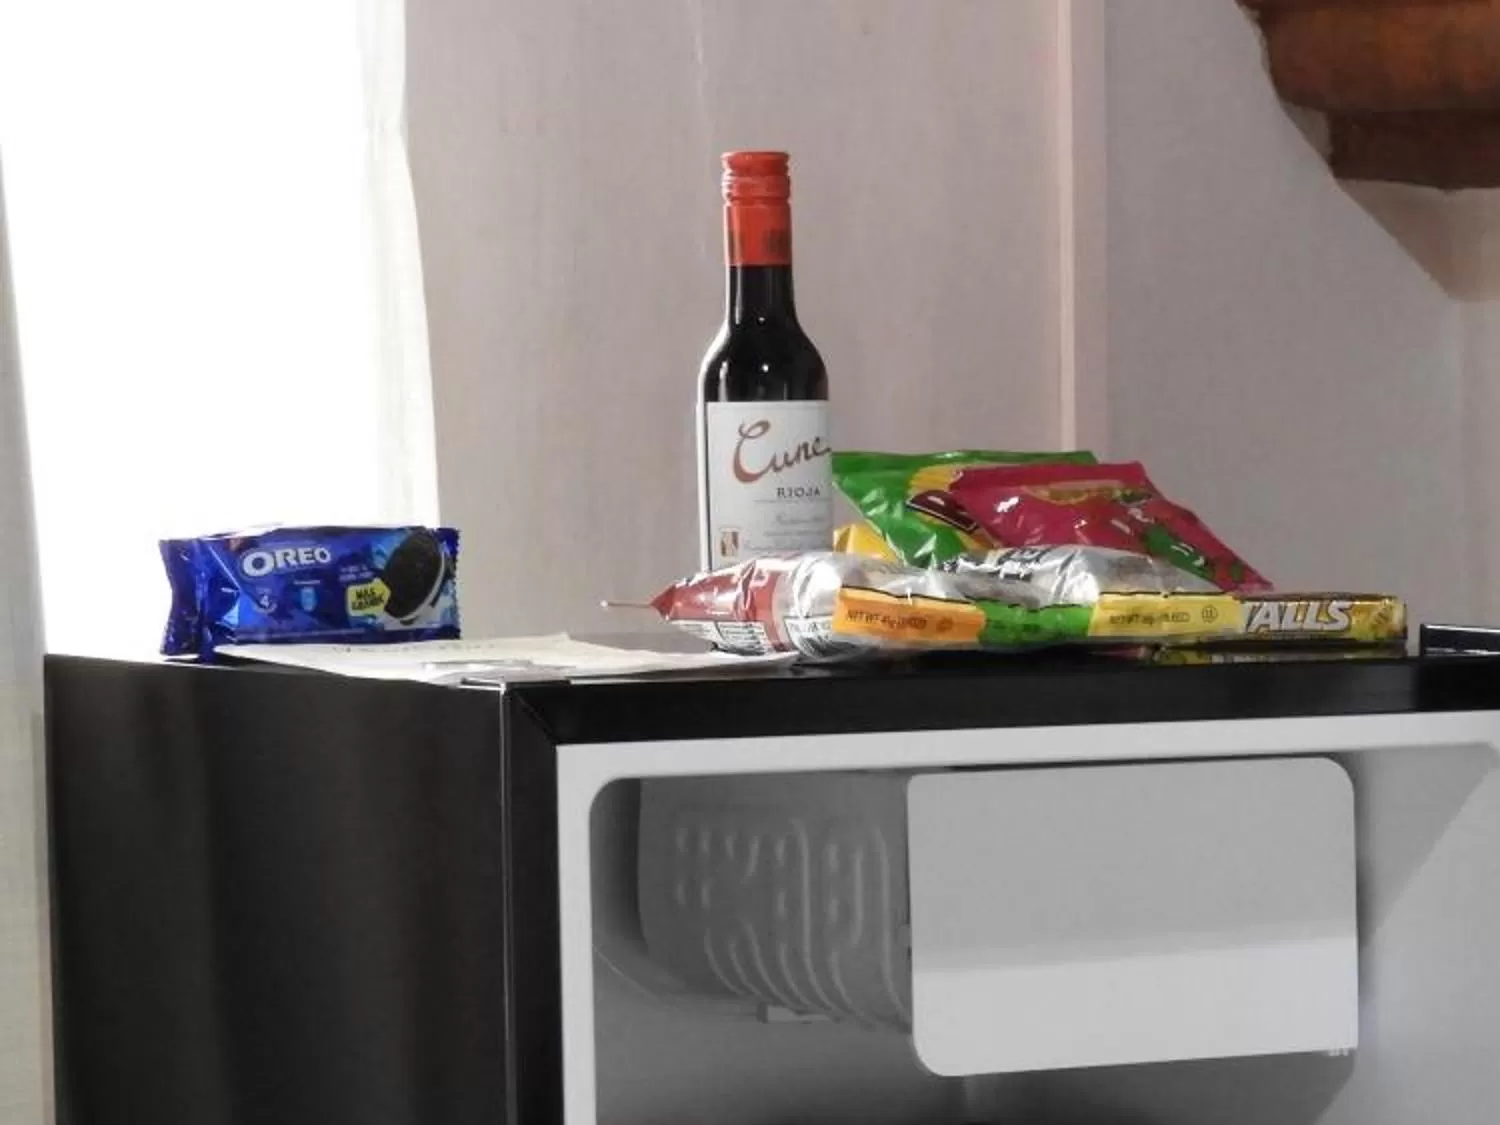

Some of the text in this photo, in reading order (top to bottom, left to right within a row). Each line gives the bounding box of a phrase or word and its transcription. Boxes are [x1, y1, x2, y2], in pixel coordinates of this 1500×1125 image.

[733, 419, 831, 483] Cune
[777, 487, 821, 498] RIOJA
[243, 547, 331, 576] OREO
[1243, 600, 1350, 633] ALLS
